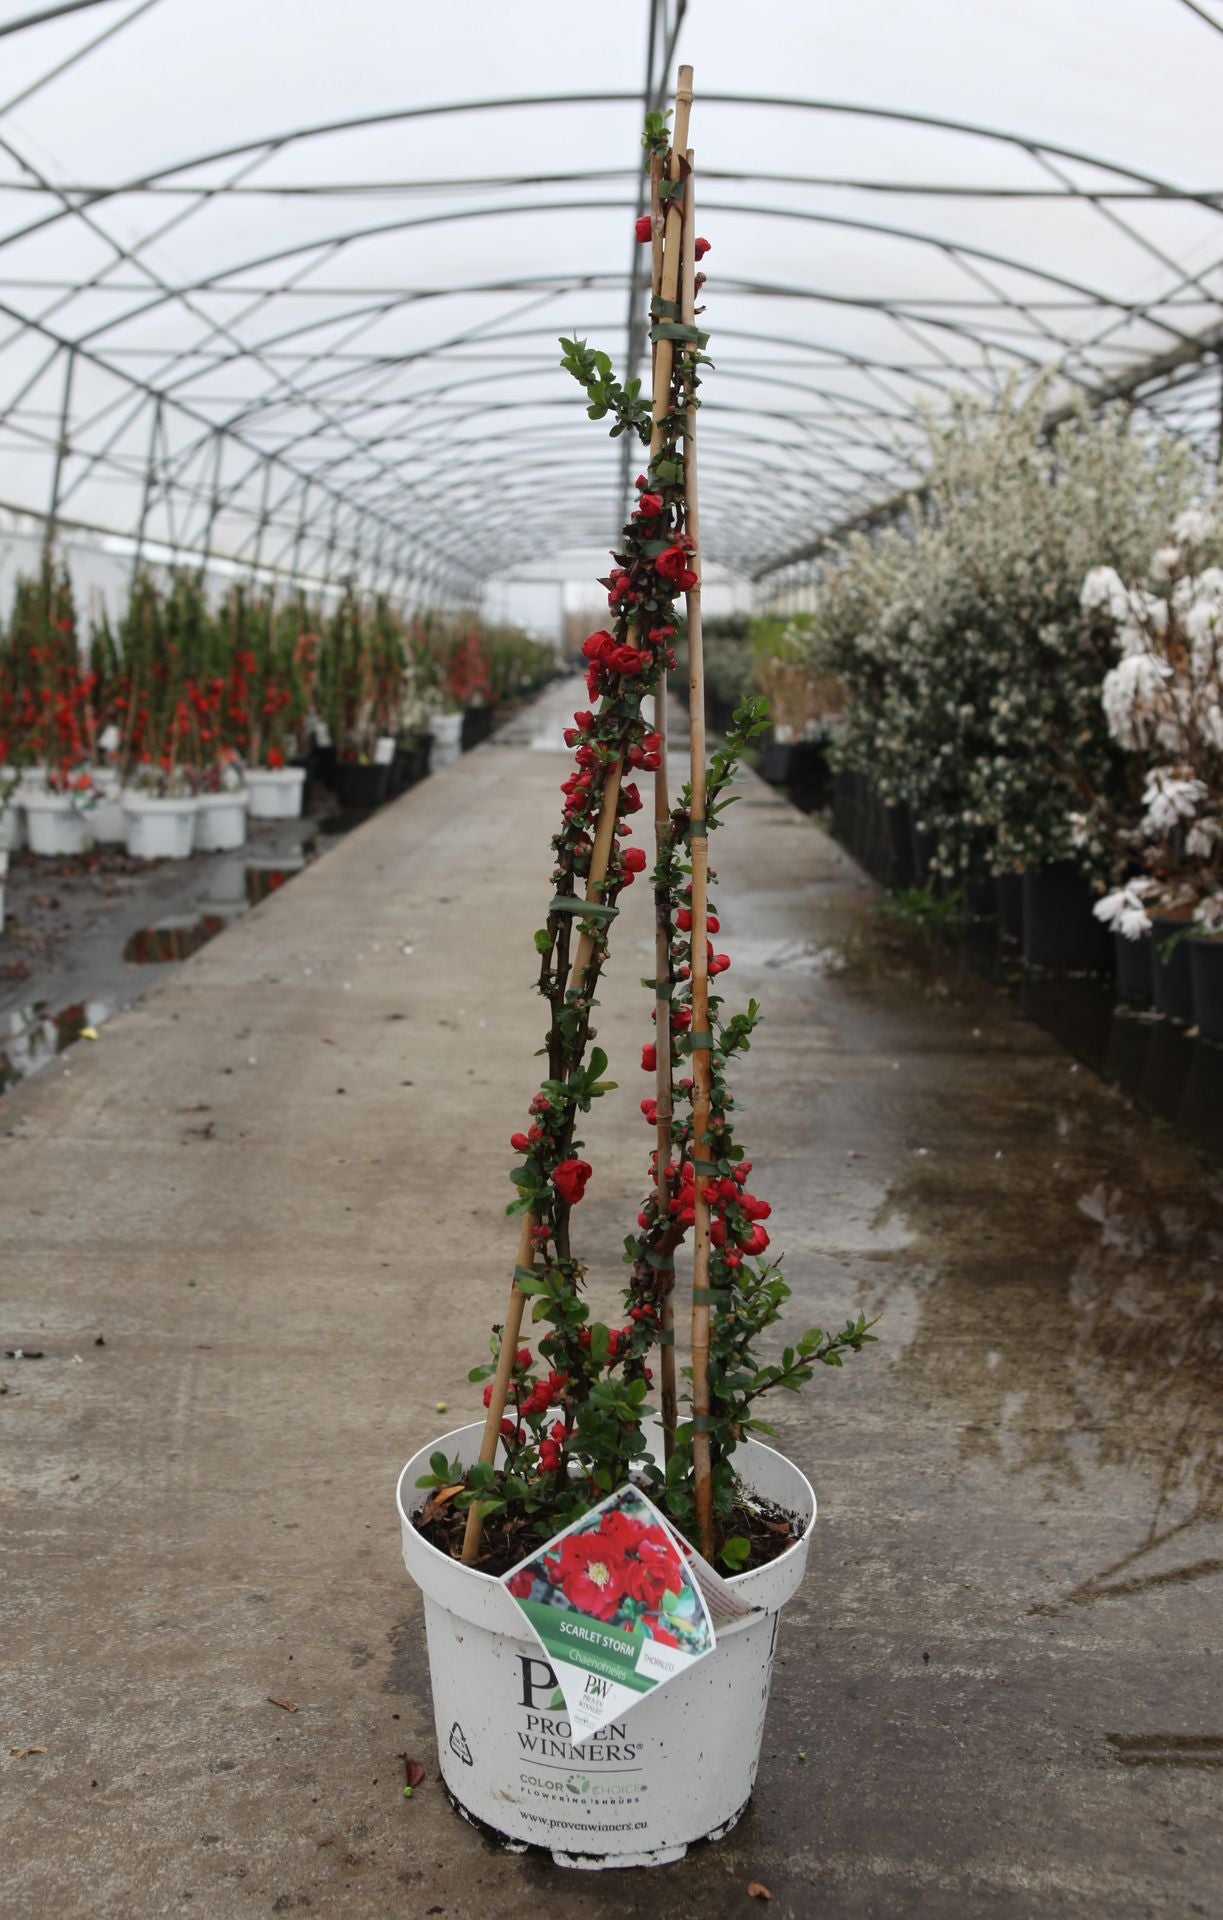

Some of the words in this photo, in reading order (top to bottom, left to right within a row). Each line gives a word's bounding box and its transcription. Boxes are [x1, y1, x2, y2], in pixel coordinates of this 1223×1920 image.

[559, 1621, 602, 1644] SCARLET
[603, 1636, 636, 1658] STORM
[569, 1648, 628, 1681] Chaenomeles
[643, 1652, 676, 1673] THORNLESS
[526, 1713, 628, 1741] PROEN
[519, 1773, 564, 1792] COLOR
[520, 1786, 587, 1805] FLOWERING
[594, 1796, 640, 1806] SHRUBS
[519, 1811, 648, 1832] www.provenwinners.eu
